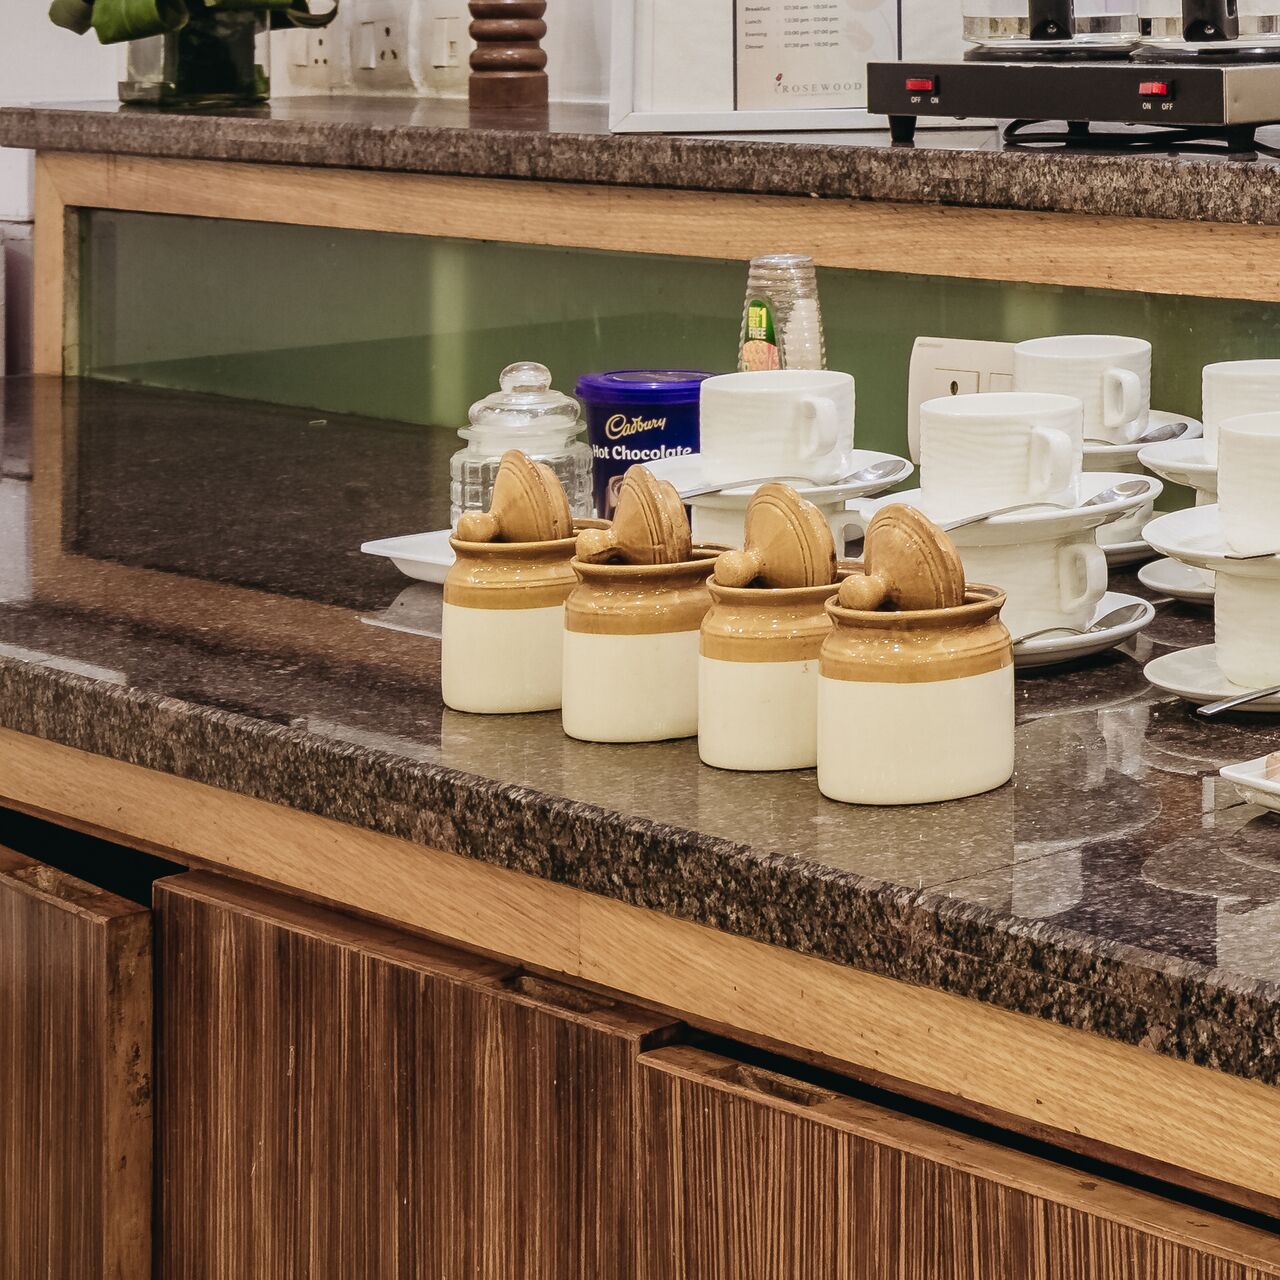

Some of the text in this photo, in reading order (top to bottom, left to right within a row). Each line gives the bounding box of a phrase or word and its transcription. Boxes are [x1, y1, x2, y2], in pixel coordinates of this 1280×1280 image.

[782, 82, 862, 94] ROSEWOOD
[911, 96, 921, 104] OFF
[1142, 102, 1174, 110] ON OFF
[748, 327, 767, 339] FREE
[605, 414, 667, 440] Cadbury
[592, 443, 692, 460] Hot Chocolate
